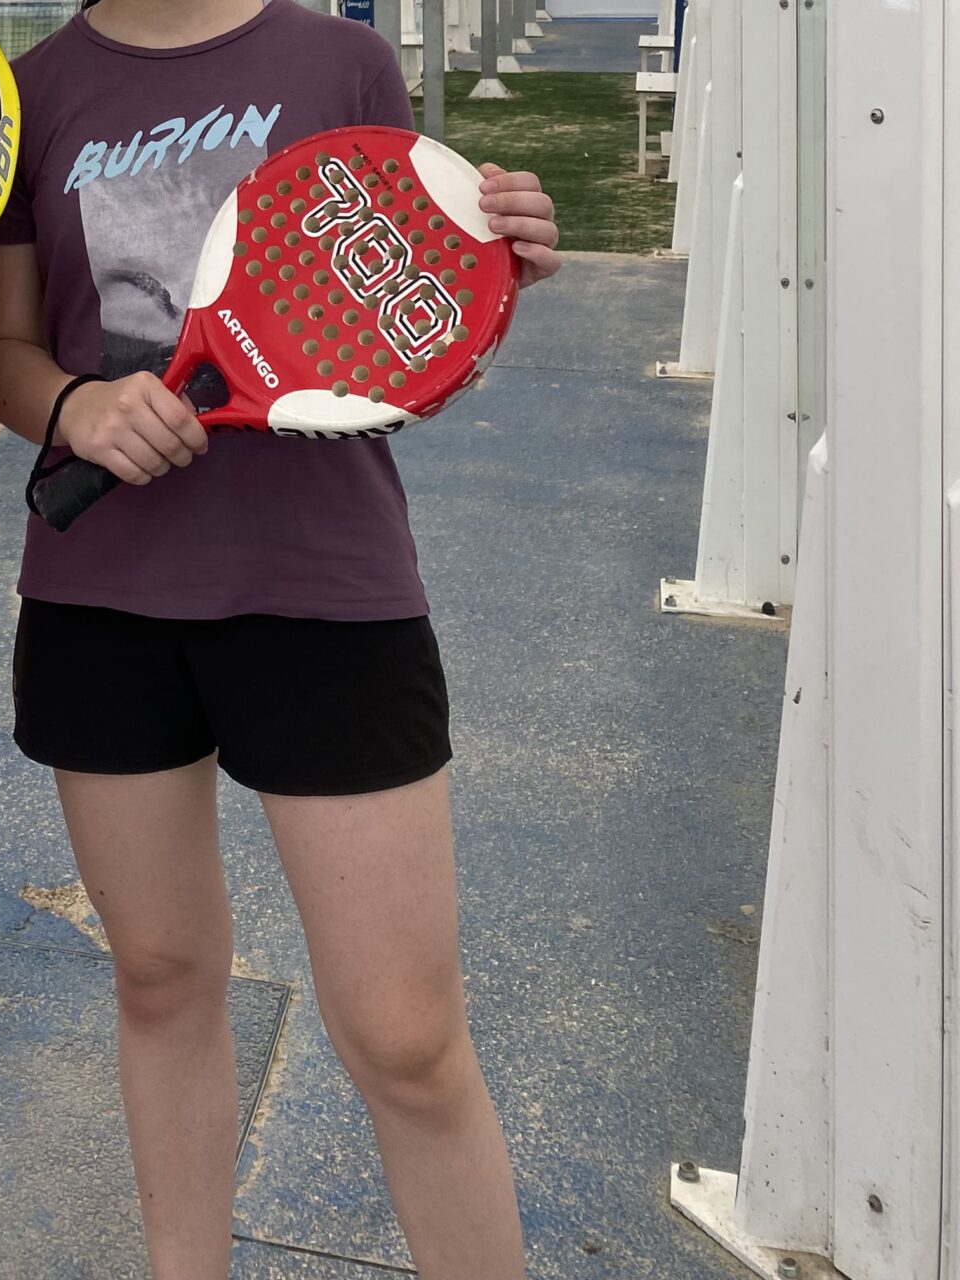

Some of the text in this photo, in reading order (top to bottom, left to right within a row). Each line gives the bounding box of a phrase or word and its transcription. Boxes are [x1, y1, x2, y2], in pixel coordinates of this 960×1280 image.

[63, 103, 282, 195] BURTON
[301, 157, 462, 370] 700
[217, 308, 280, 389] ARTENGO
